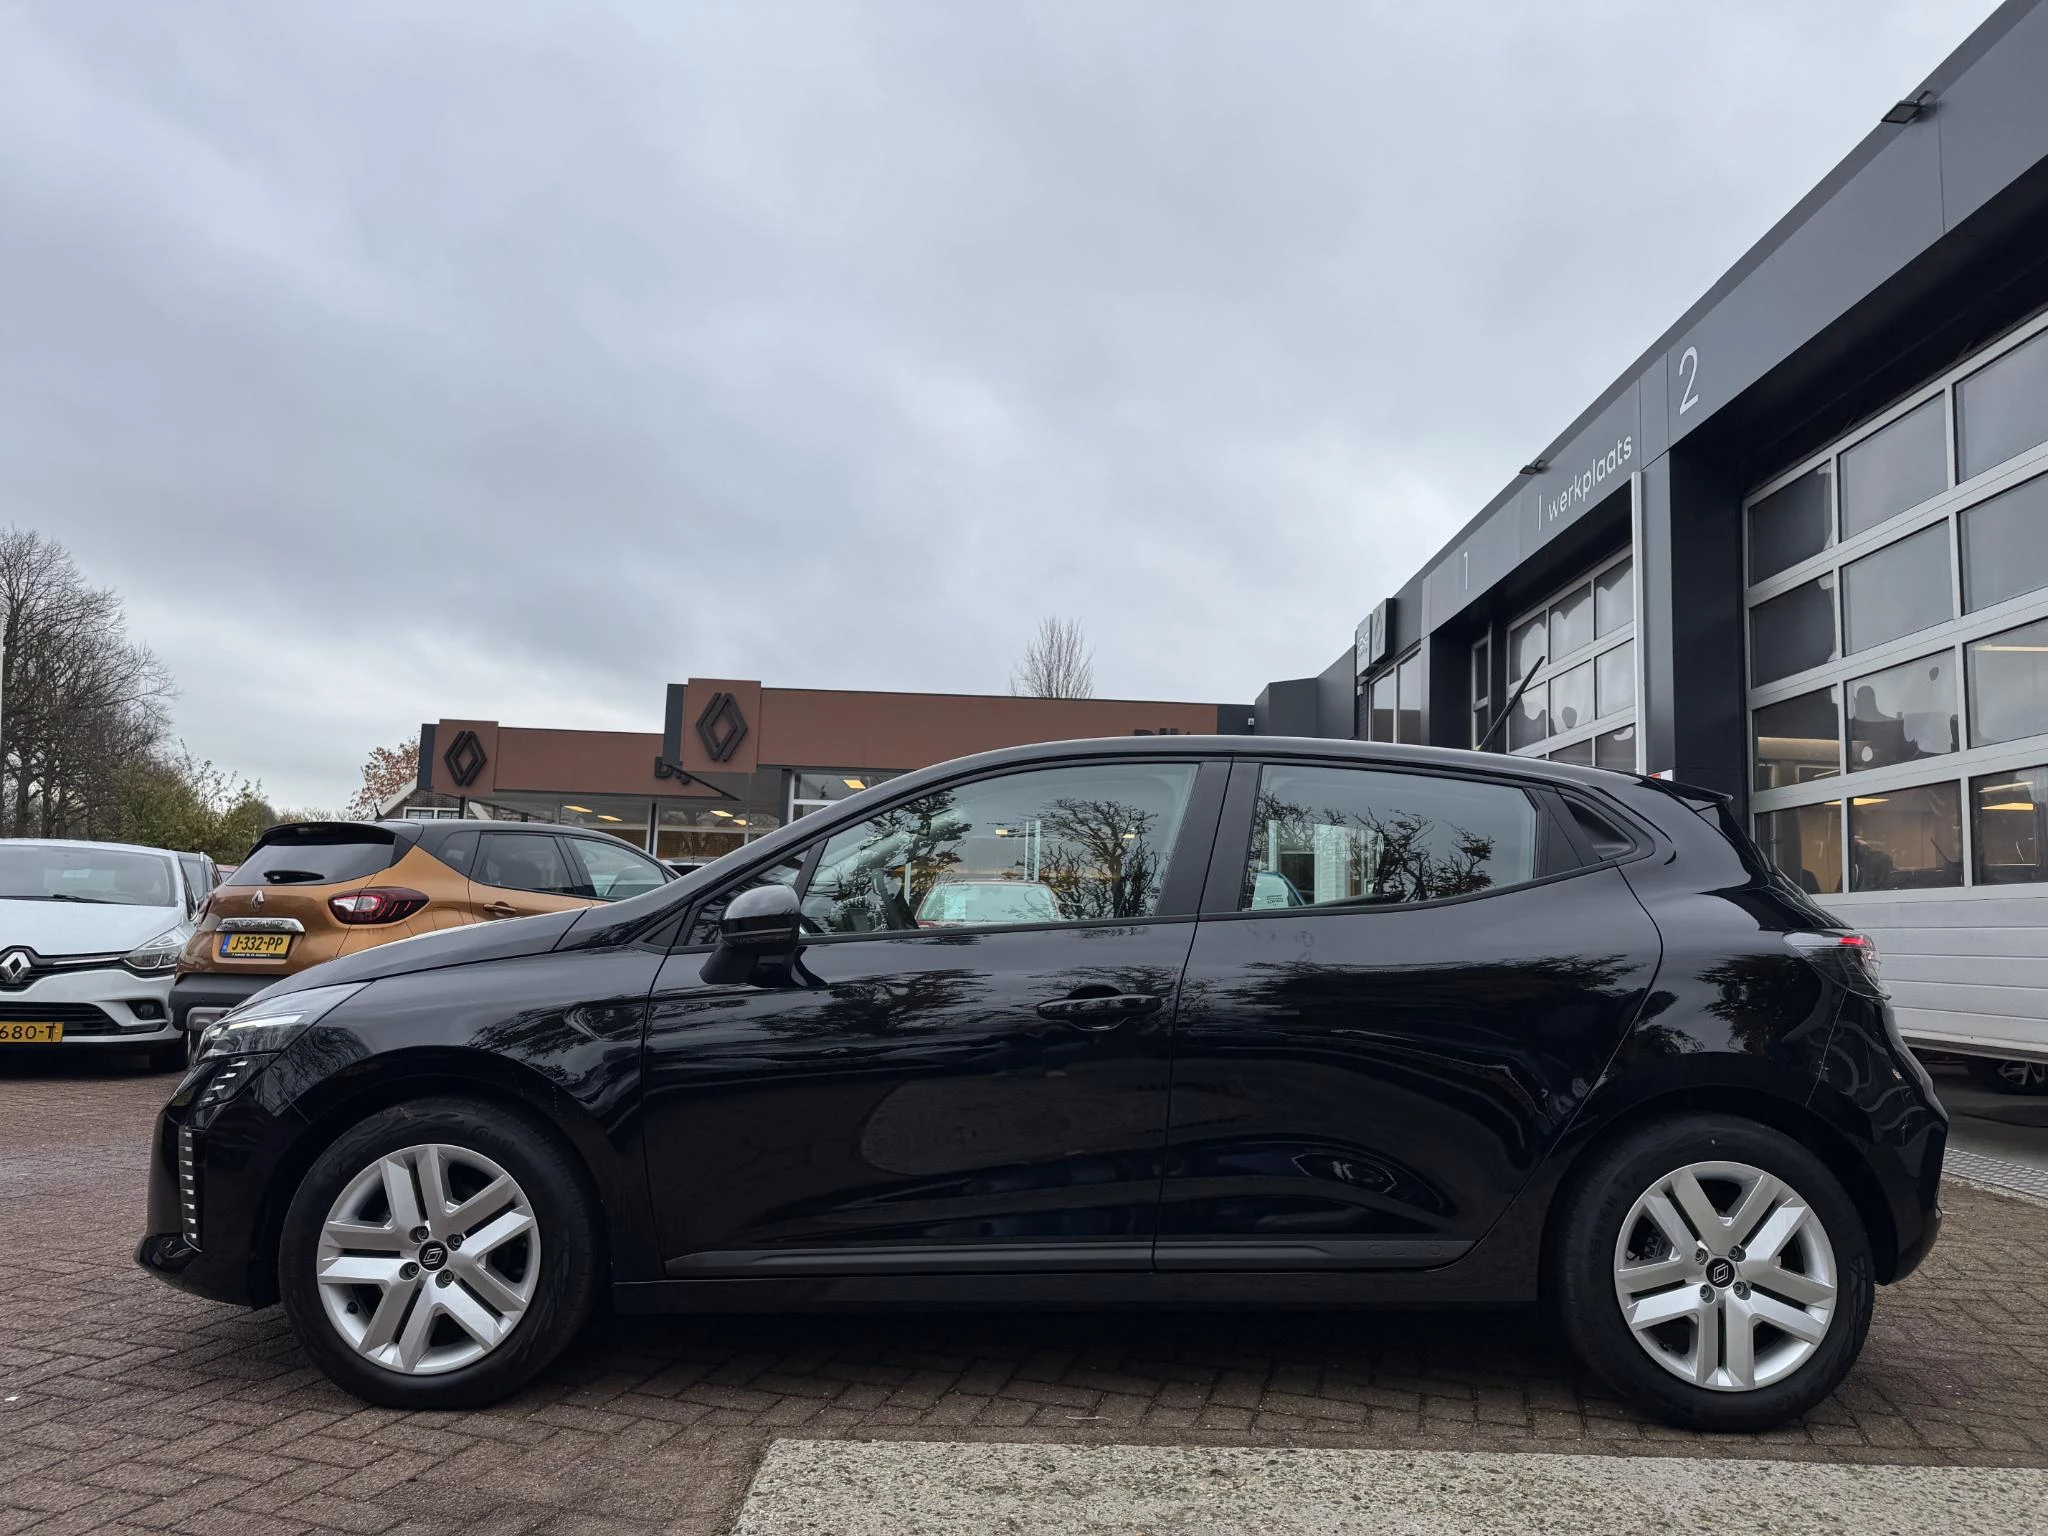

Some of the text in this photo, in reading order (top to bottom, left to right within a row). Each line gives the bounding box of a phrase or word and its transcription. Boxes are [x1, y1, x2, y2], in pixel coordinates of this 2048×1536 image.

[1679, 346, 1699, 416] 2
[1548, 435, 1632, 522] werkplaats
[231, 936, 284, 952] J-332-PP
